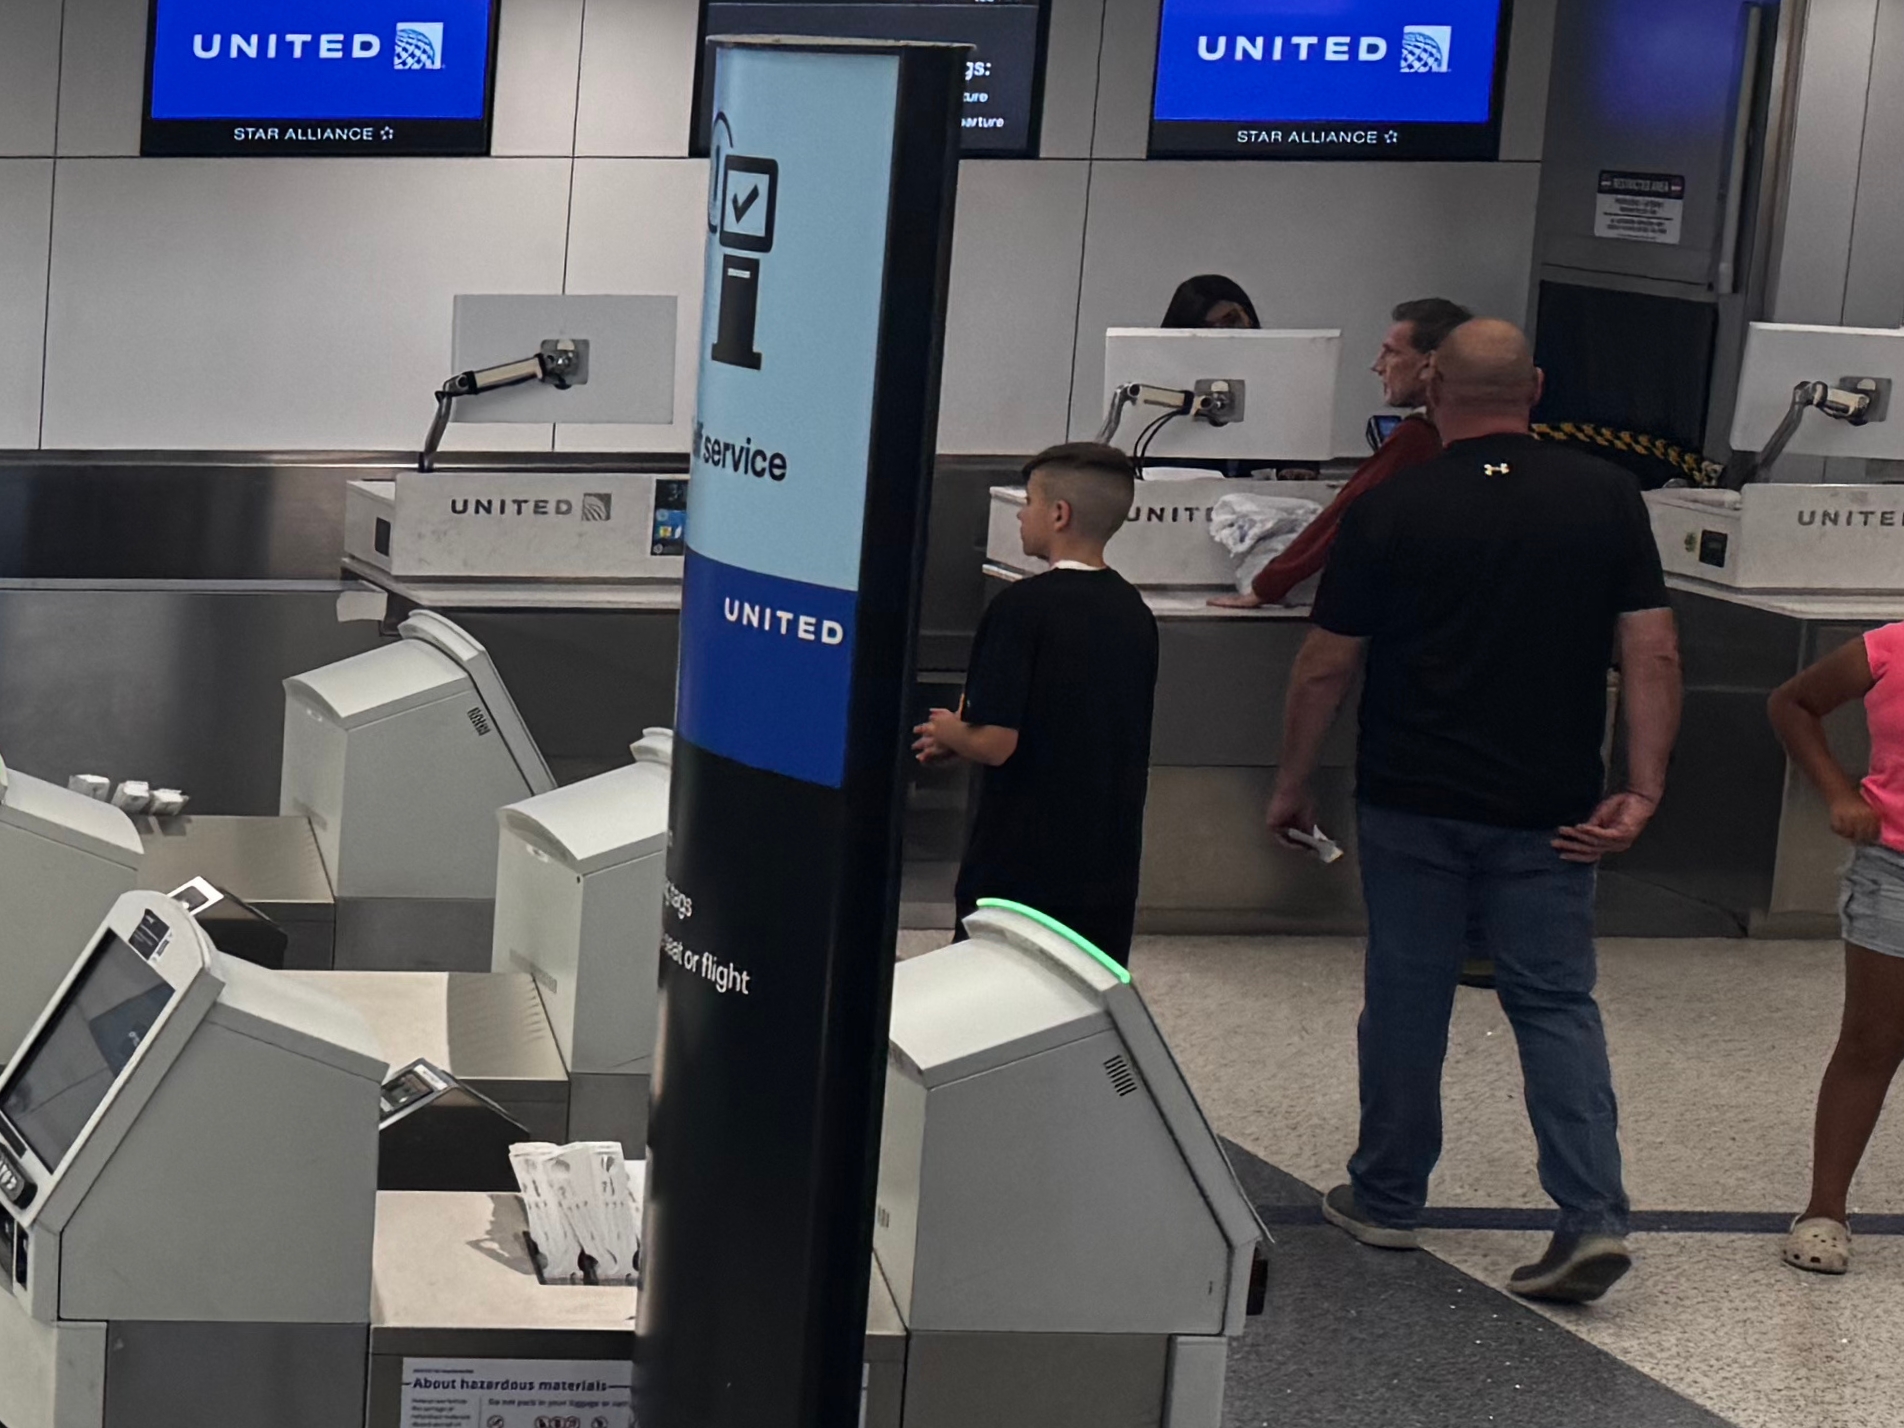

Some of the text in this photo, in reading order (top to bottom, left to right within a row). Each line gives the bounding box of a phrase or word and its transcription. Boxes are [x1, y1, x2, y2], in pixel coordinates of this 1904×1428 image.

[193, 33, 382, 60] UNITED
[1197, 34, 1388, 62] UNITED
[233, 126, 374, 141] STAR ALLIANCE
[1237, 129, 1378, 144] STAR ALLIANCE
[703, 436, 787, 481] service
[450, 498, 573, 516] UNITED
[1797, 510, 1904, 527] UNITE
[724, 596, 844, 646] UNITED
[684, 950, 700, 973] or
[702, 951, 751, 995] flight
[413, 1378, 607, 1391] About hazardous materials
